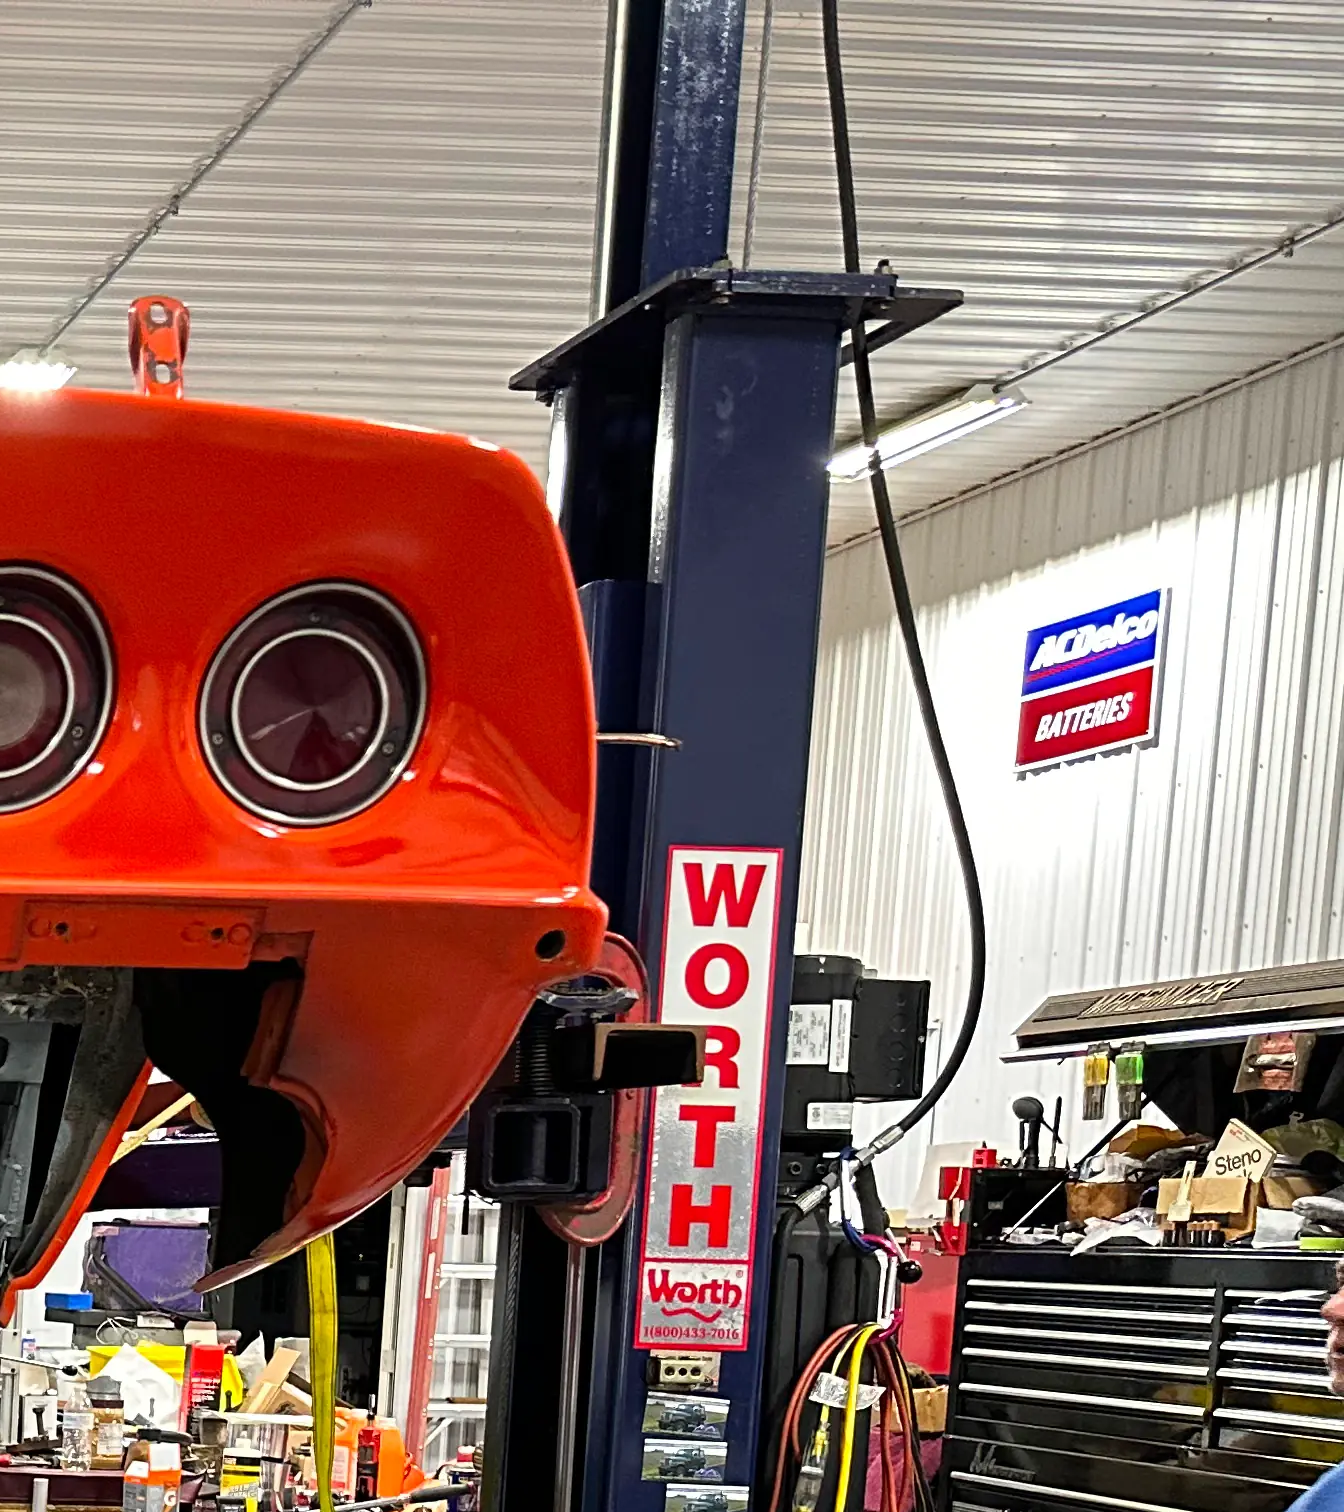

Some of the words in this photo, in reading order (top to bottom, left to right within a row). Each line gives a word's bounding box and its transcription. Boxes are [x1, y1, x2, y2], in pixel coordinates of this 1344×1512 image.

[1029, 609, 1159, 672] ACDelco
[1034, 691, 1135, 743] BATTERIES
[666, 862, 767, 1249] WORTH
[1215, 1148, 1262, 1176] Steno
[647, 1268, 743, 1309] Worth
[642, 1324, 740, 1341] 1(800)433-7016
